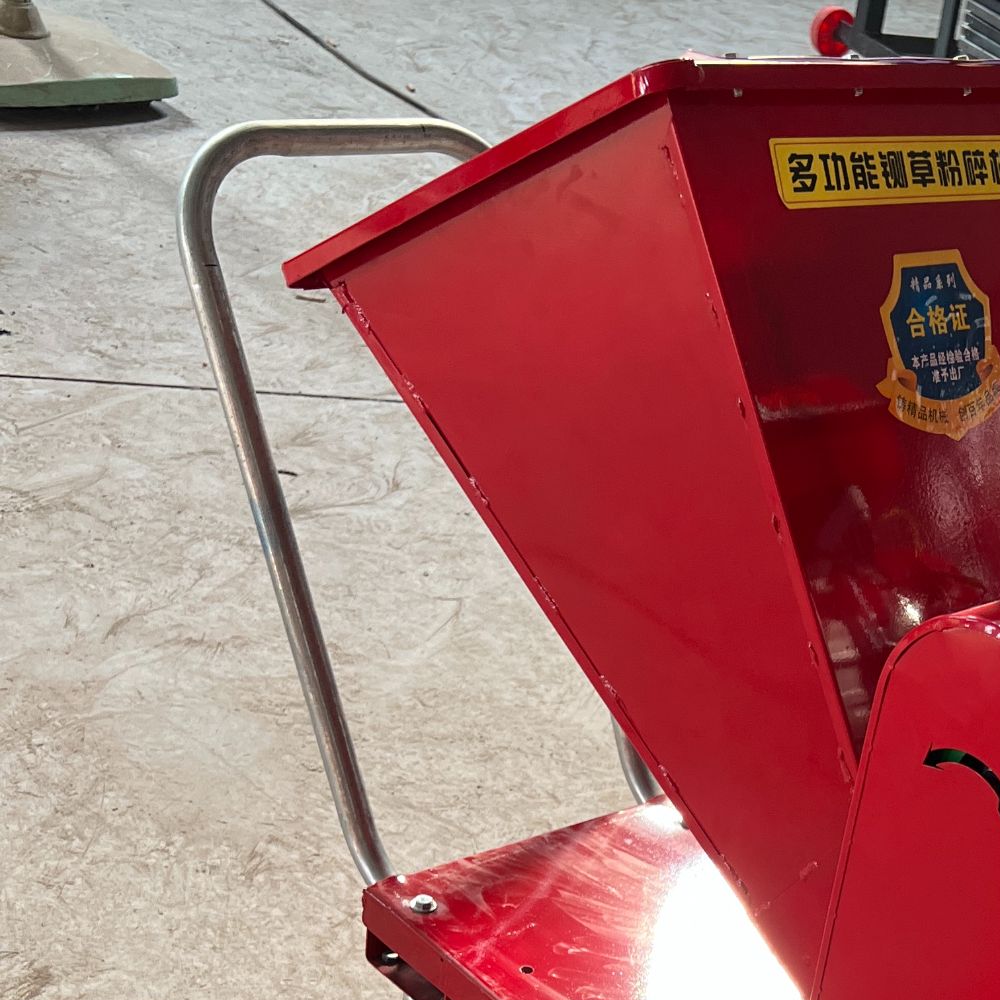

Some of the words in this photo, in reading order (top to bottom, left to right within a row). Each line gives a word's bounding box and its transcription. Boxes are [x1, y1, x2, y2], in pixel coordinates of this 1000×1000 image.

[909, 272, 958, 293] 精品系列
[906, 303, 971, 338] 合格证
[911, 346, 980, 369] 本产品经检验合格
[931, 365, 965, 384] 准予出厂
